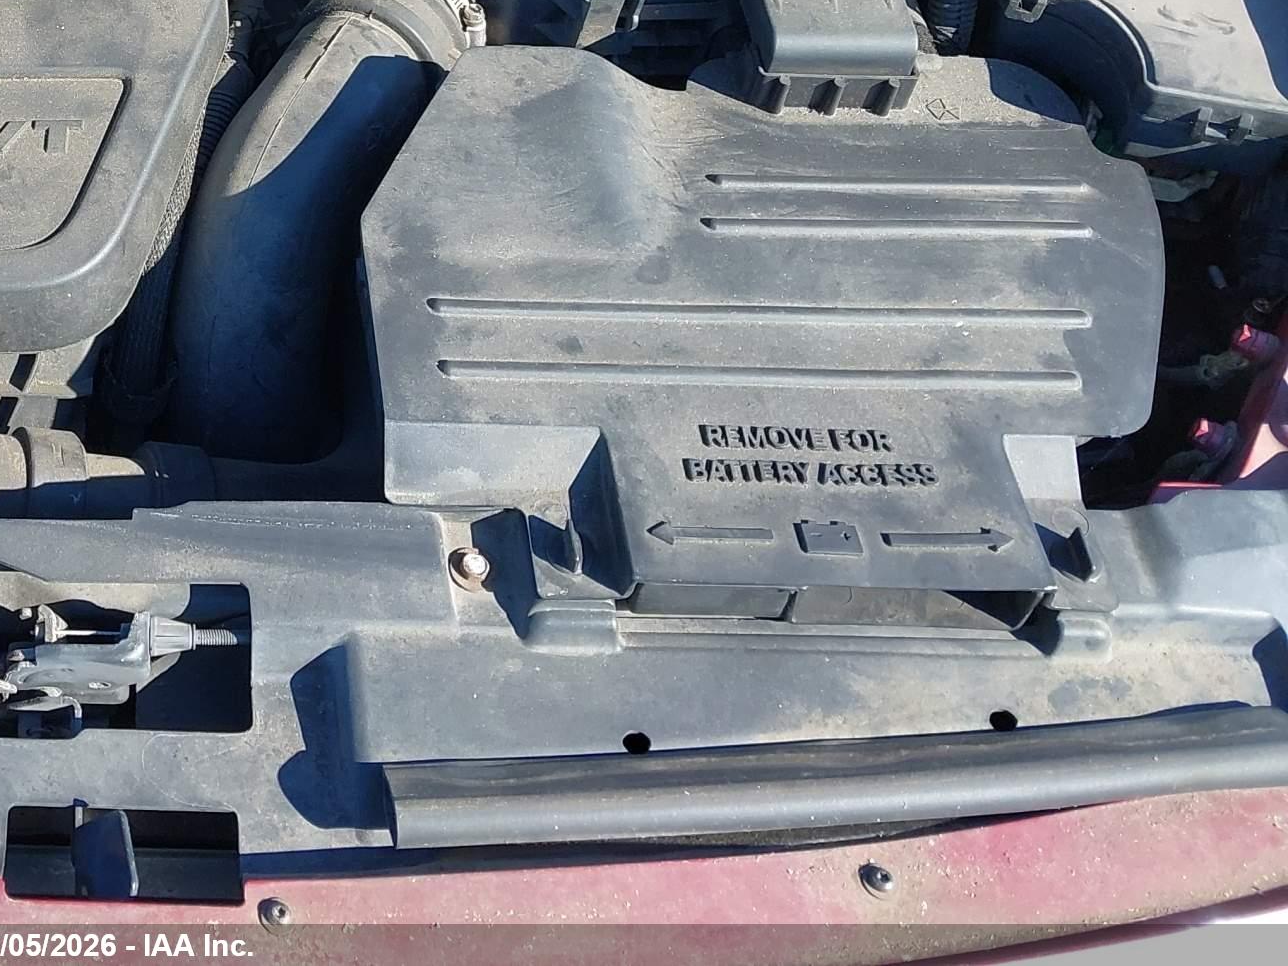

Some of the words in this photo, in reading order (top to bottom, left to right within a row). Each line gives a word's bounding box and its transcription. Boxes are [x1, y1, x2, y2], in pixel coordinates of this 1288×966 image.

[698, 424, 828, 452] REMOVE
[827, 428, 896, 453] FOR
[682, 457, 811, 484] BATTERY
[815, 461, 941, 487] ACCESS
